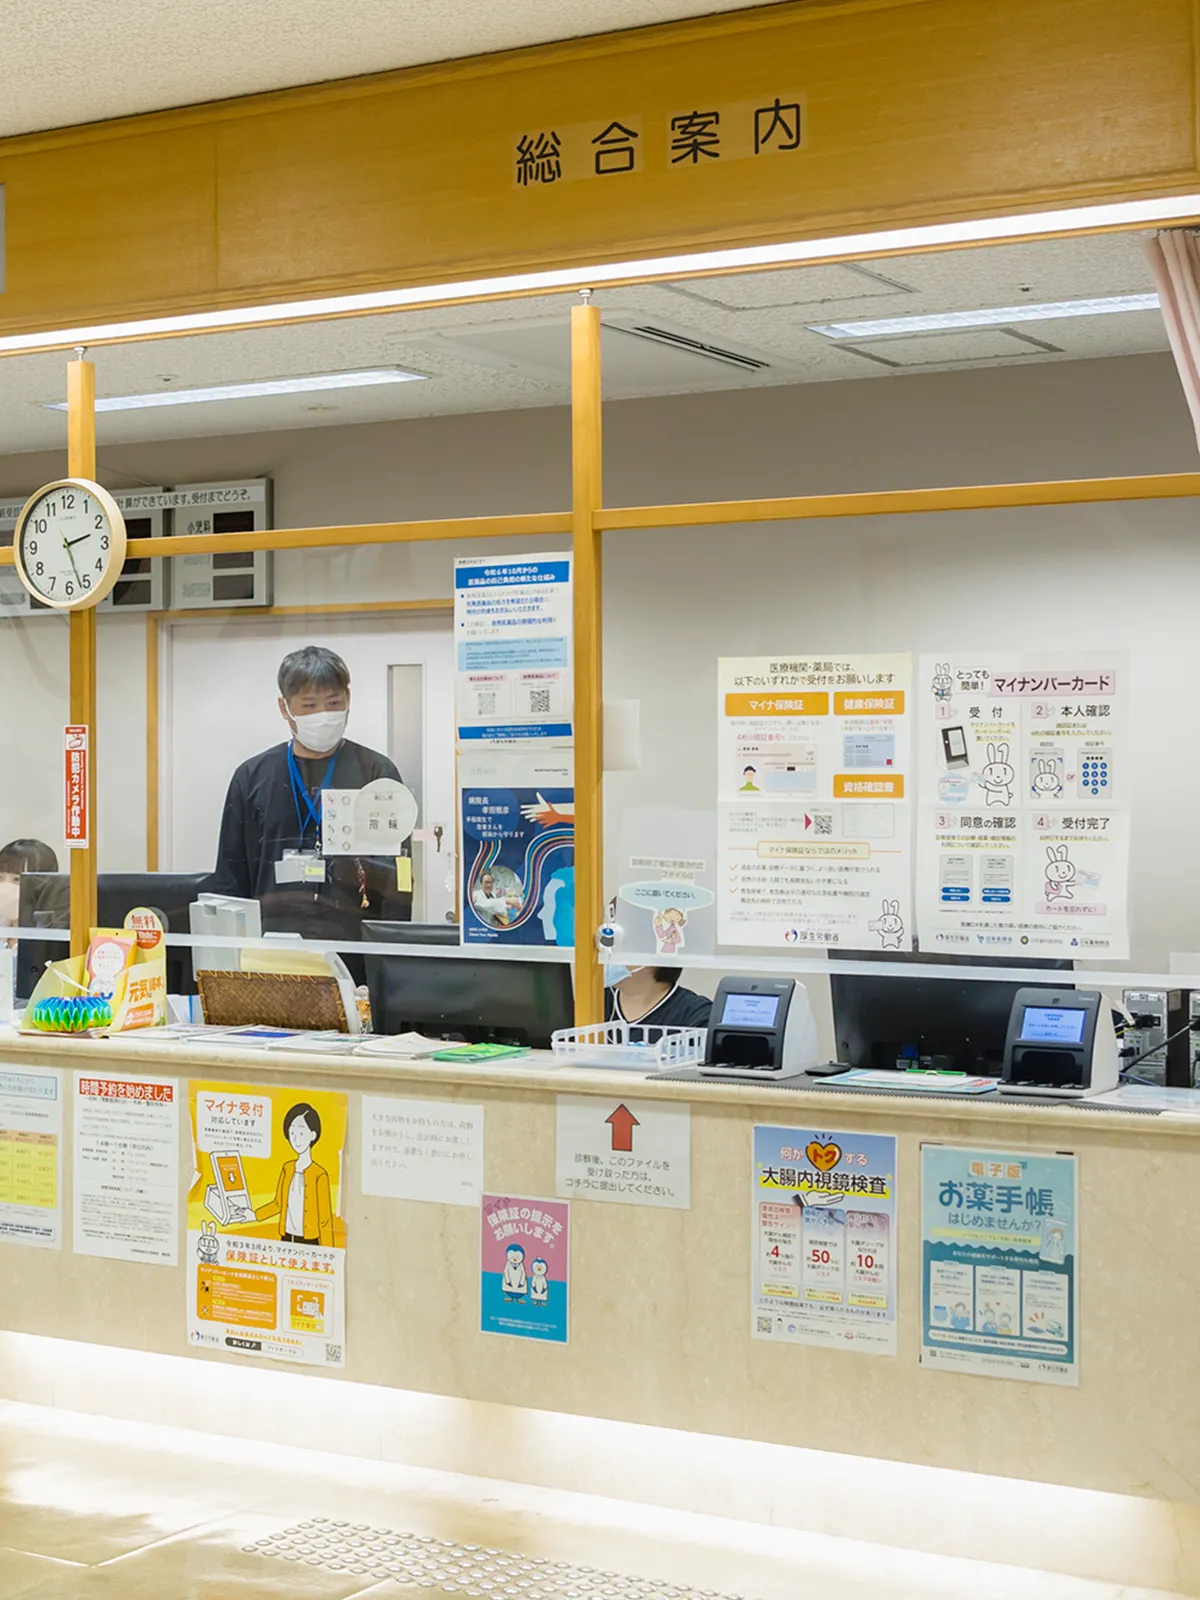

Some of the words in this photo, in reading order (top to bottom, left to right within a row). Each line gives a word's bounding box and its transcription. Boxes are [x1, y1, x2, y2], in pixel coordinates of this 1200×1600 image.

[516, 98, 801, 185] 総合案内
[61, 494, 75, 509] 12
[84, 499, 88, 514] 1
[46, 502, 56, 517] 11
[34, 519, 47, 534] 10
[94, 515, 103, 529] 2
[188, 520, 211, 534] 小児科
[29, 541, 38, 555] 9
[101, 535, 109, 550] 3
[36, 561, 44, 576] 8
[95, 557, 103, 572] 4
[49, 576, 56, 591] 7
[65, 581, 74, 595] 6
[82, 574, 91, 589] 5
[769, 662, 855, 674] 医療機関・薬局では、
[956, 669, 989, 680] とっても
[734, 673, 895, 687] 以下のいずれかで受付をお願いします
[960, 681, 984, 691] 簡単！
[994, 675, 1110, 692] マイナンバーカード
[749, 699, 804, 711] マイナ保険証
[843, 698, 895, 710] 健康保険証
[1036, 705, 1043, 716] 2
[1061, 704, 1110, 717] 本人確認
[969, 706, 1003, 718] 受付
[71, 751, 81, 837] 防犯カメラ作動中
[843, 781, 894, 793] 資格確認書
[468, 796, 489, 805] 病院長
[939, 816, 945, 826] 3
[960, 817, 1016, 830] 同意の確認
[1037, 817, 1044, 827] 4
[1062, 817, 1110, 830] 受付完了
[131, 914, 155, 928] 無料
[80, 1079, 173, 1102] 時間予約を始めました
[204, 1099, 264, 1118] マイナ受付
[211, 1116, 256, 1127] 対応しています
[574, 1153, 670, 1171] 診察後、このファイルを
[587, 1167, 652, 1182] 受け取った方は、
[971, 1161, 1021, 1179] 電子版
[565, 1178, 674, 1197] コチラに提出してください。
[762, 1167, 886, 1195] 大腸内視鏡検査
[938, 1179, 1054, 1218] お薬手帳
[487, 1207, 564, 1236] 保険証の提示を
[948, 1212, 1041, 1232] はじめませんか？
[493, 1222, 555, 1249] お願いします。
[226, 1250, 336, 1275] 保険証として使えます。
